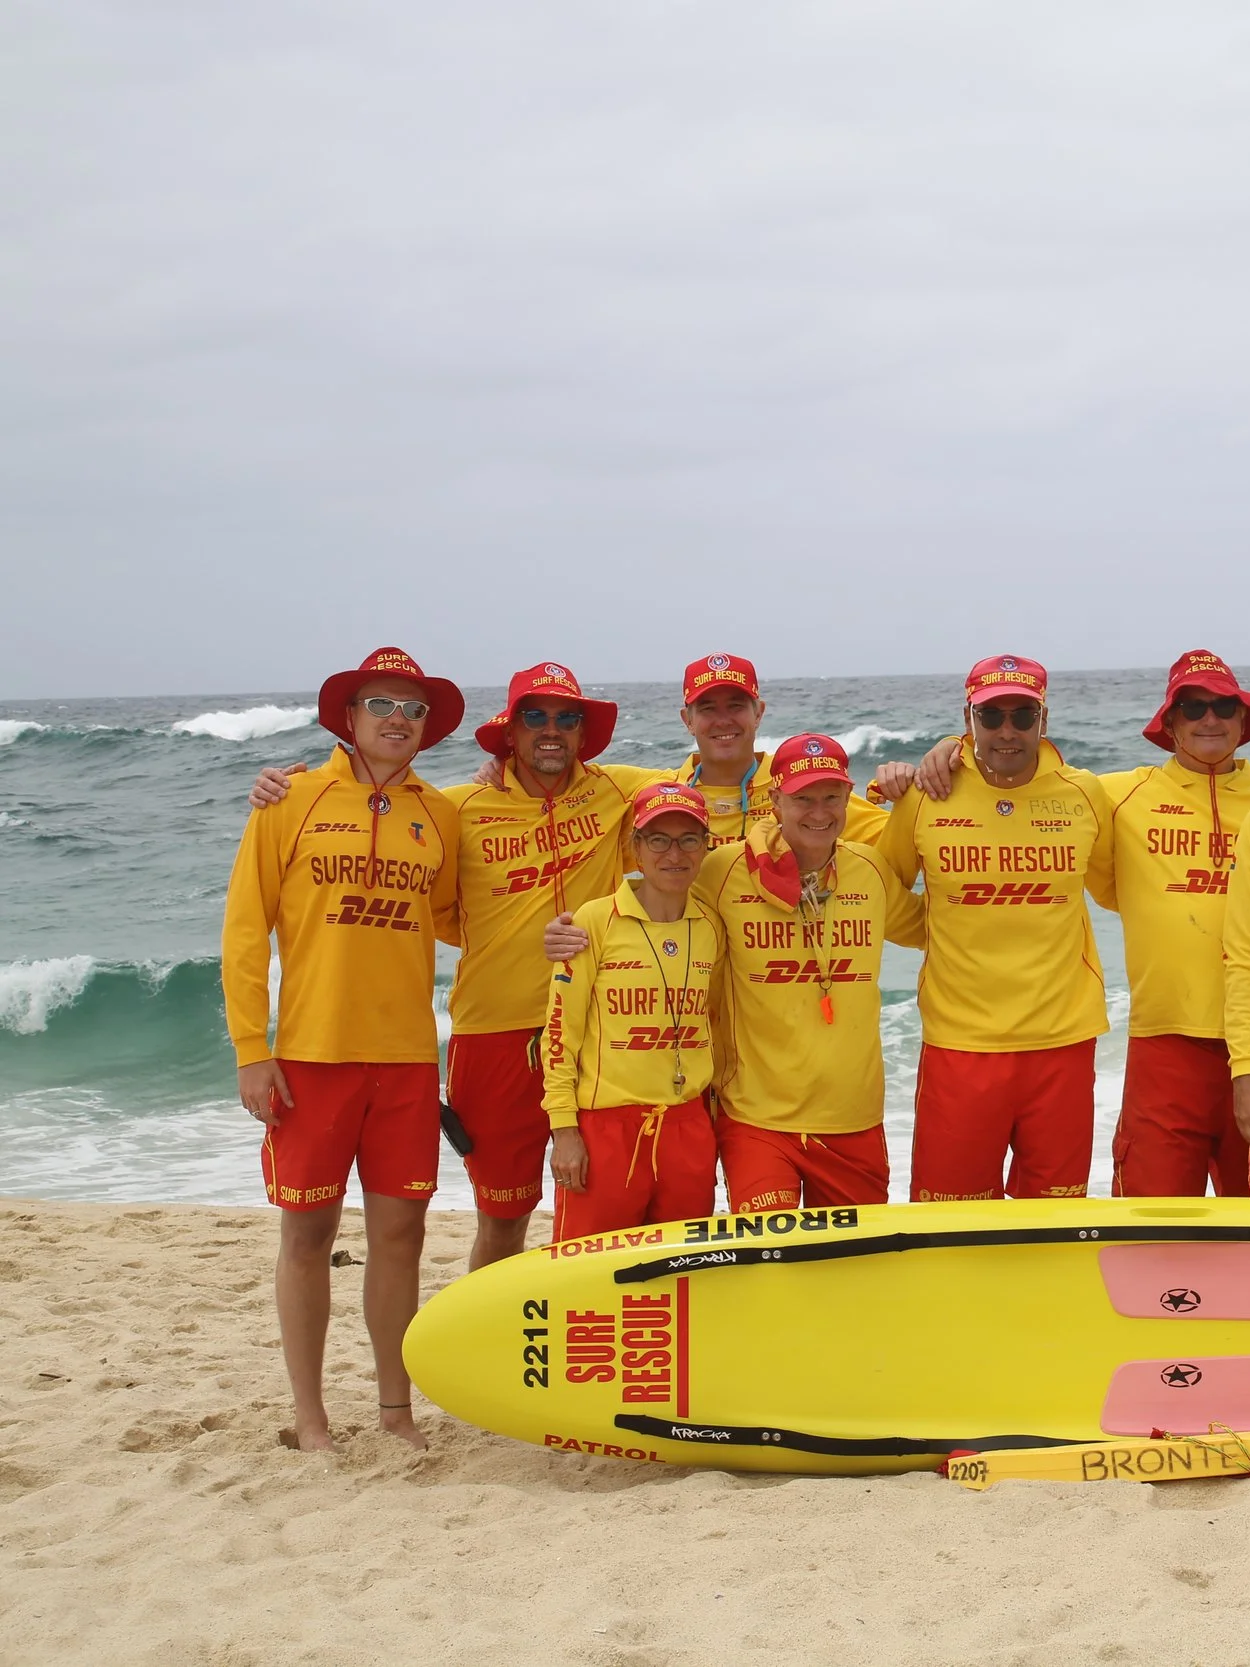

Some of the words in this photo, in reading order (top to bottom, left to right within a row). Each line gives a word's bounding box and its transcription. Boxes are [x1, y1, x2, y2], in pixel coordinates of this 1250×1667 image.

[377, 653, 409, 662] SURF
[1189, 655, 1218, 664] SURF
[532, 676, 553, 688] SURF
[694, 672, 714, 688] SURF
[716, 670, 746, 685] RESCUE
[981, 673, 1003, 687] SURF
[1005, 671, 1036, 686] RESCUE
[789, 759, 811, 774] SURF
[812, 756, 841, 771] RESCUE
[561, 789, 595, 805] ISUZU
[567, 799, 589, 809] UTE
[645, 795, 665, 811] SURF
[666, 794, 699, 810] RESCUE
[1029, 800, 1085, 817] PABLO
[1159, 804, 1186, 815] DHL
[313, 823, 361, 833] DHL
[479, 816, 518, 825] DHL
[935, 819, 976, 827] DHL
[482, 831, 529, 864] SURF
[534, 813, 606, 853] RESCUE
[1147, 828, 1202, 857] SURF
[938, 846, 992, 873] SURF
[998, 846, 1076, 872] RESCUE
[310, 855, 367, 886] SURF
[374, 858, 437, 895] RESCU
[1185, 869, 1231, 895] DH
[739, 894, 767, 904] DH
[835, 893, 869, 901] SUZU
[960, 883, 1053, 905] DHL
[337, 895, 412, 931] DHL
[743, 921, 796, 949] SURF
[802, 919, 873, 948] RESCUE
[604, 960, 645, 970] DHL
[691, 961, 713, 970] ISUZ
[763, 959, 858, 984] DHL
[606, 987, 659, 1016] SURF
[663, 987, 707, 1016] RESC
[627, 1026, 699, 1051] DHL
[280, 1185, 302, 1204] SURF
[304, 1182, 341, 1204] RESCUE
[411, 1181, 434, 1191] DH
[490, 1188, 514, 1203] SURF
[751, 1191, 778, 1210] SURF
[550, 1229, 664, 1259] PATROL
[684, 1208, 858, 1244] BRONTE
[523, 1299, 549, 1388] 2212
[565, 1310, 617, 1384] SURF
[620, 1293, 672, 1403] RESCUE
[671, 1426, 731, 1441] KRACKA
[544, 1434, 667, 1463] PATROL
[950, 1460, 988, 1482] 2207
[1081, 1443, 1240, 1482] BRONTE
